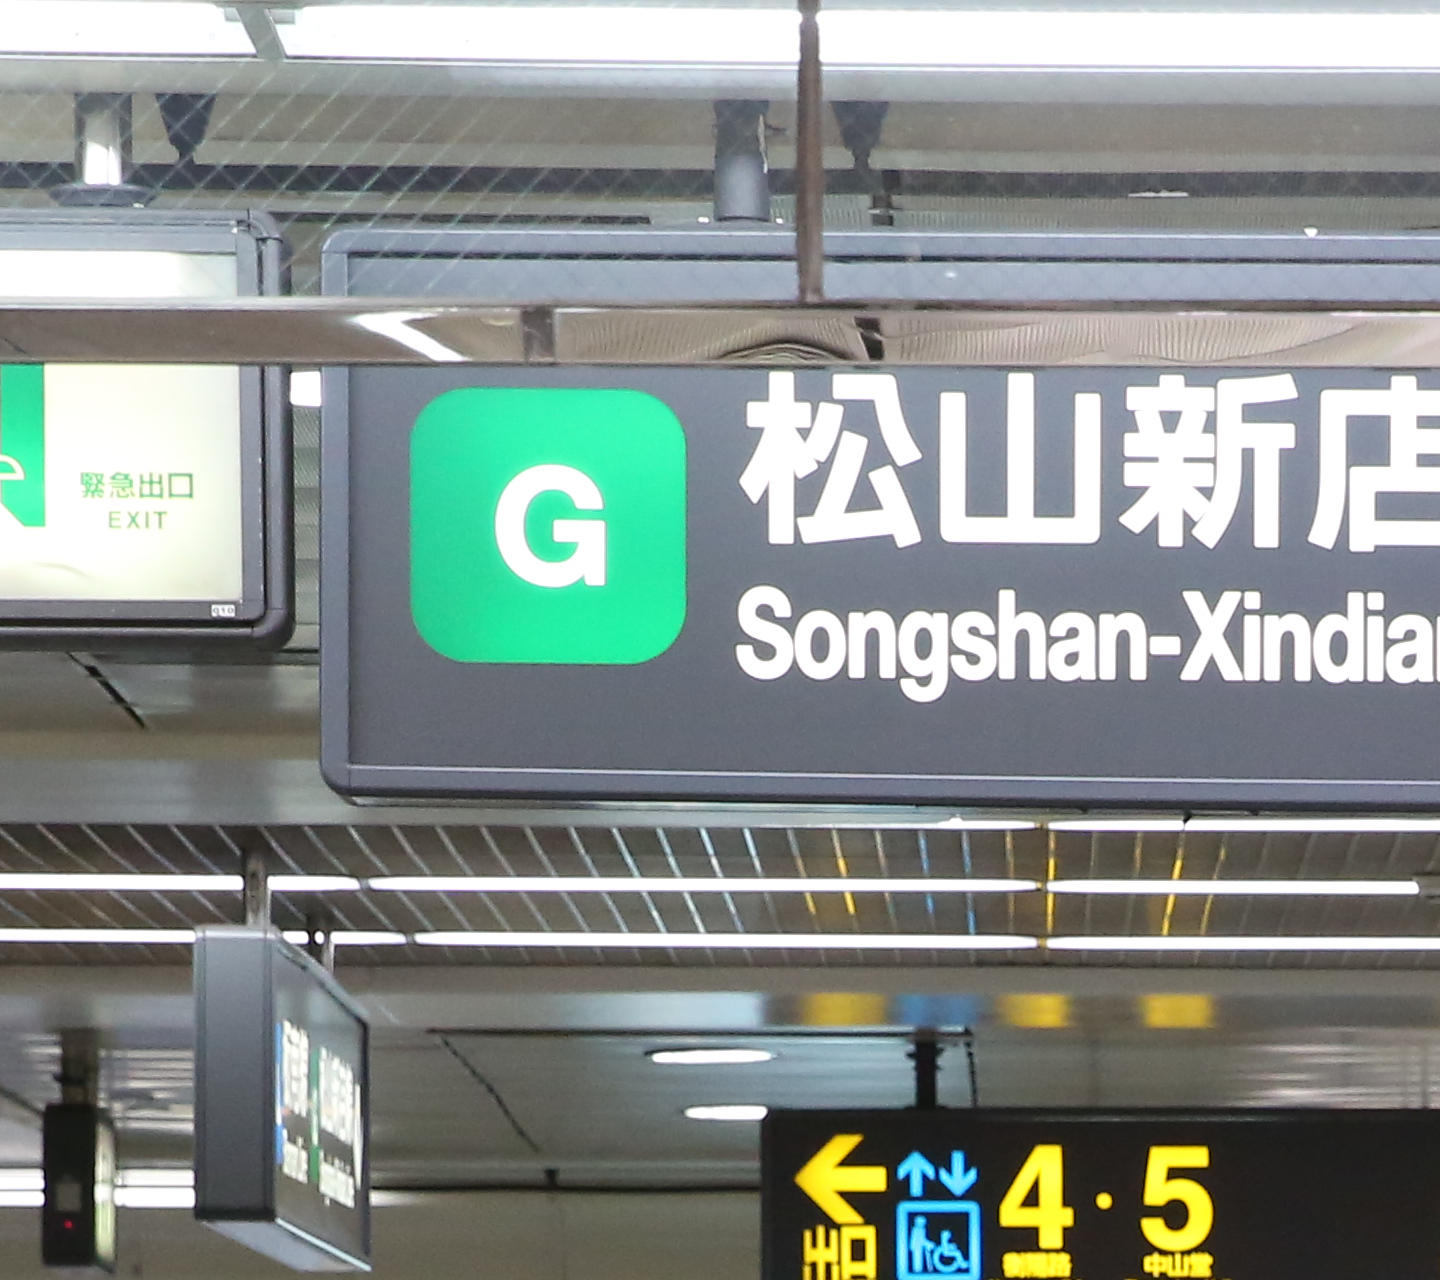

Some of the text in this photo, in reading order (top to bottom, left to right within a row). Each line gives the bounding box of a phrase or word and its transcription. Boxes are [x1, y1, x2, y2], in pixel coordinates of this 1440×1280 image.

[80, 472, 195, 500] 緊急出口
[109, 511, 168, 530] EXIT
[496, 465, 605, 587] G
[999, 1144, 1214, 1251] 4 5
